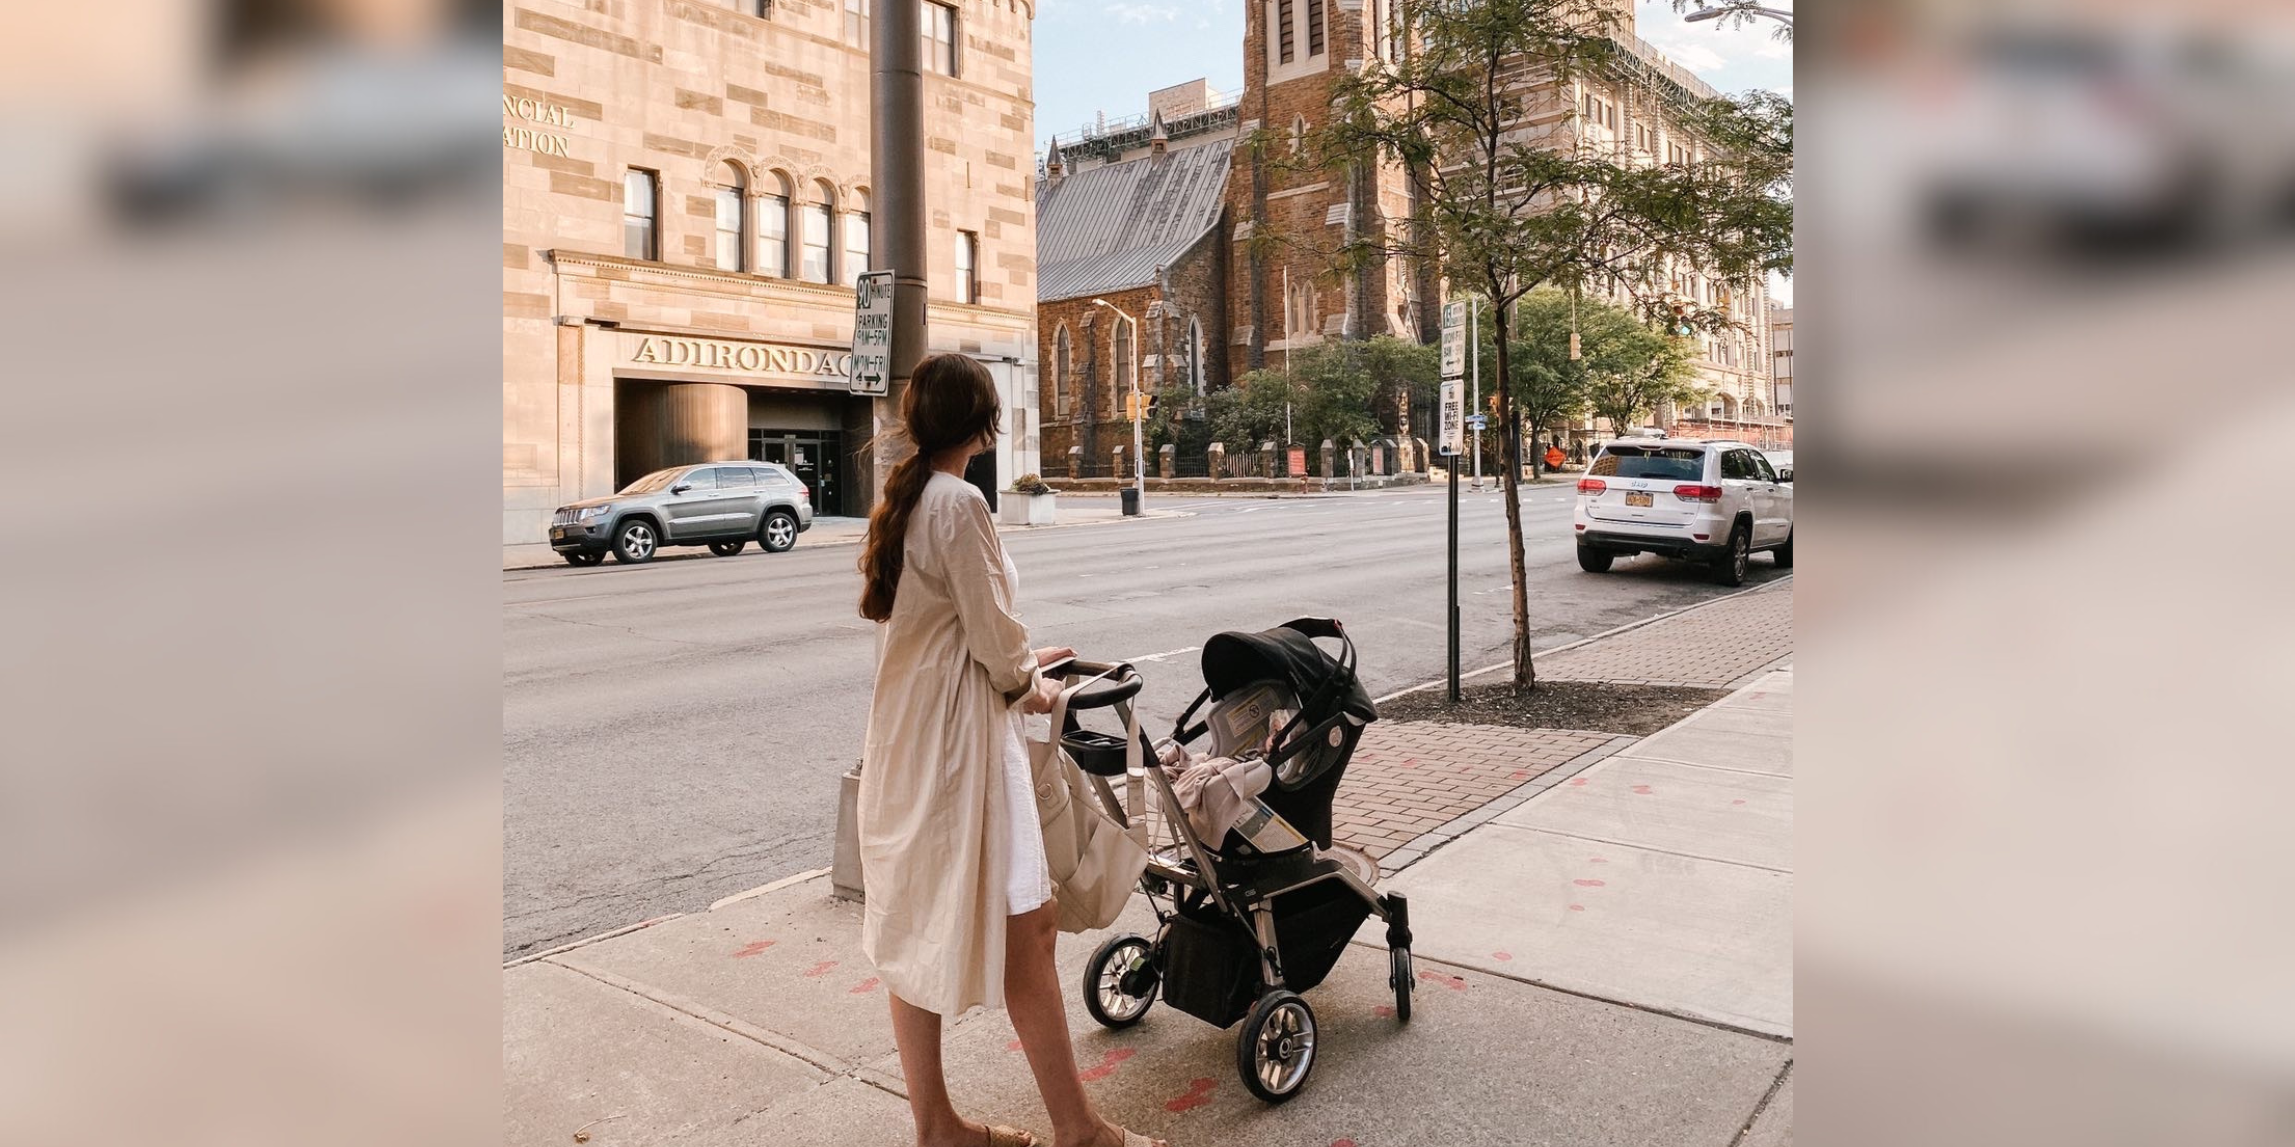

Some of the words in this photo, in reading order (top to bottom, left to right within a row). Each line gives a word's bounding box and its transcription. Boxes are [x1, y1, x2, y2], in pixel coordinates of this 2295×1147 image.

[858, 279, 871, 308] 90
[871, 284, 891, 299] MINUTE
[859, 314, 888, 330] PARKING
[853, 354, 886, 372] MON-FRI
[1445, 401, 1459, 411] FREE
[1445, 411, 1459, 421] WI-FI
[1444, 421, 1459, 431] ZONE
